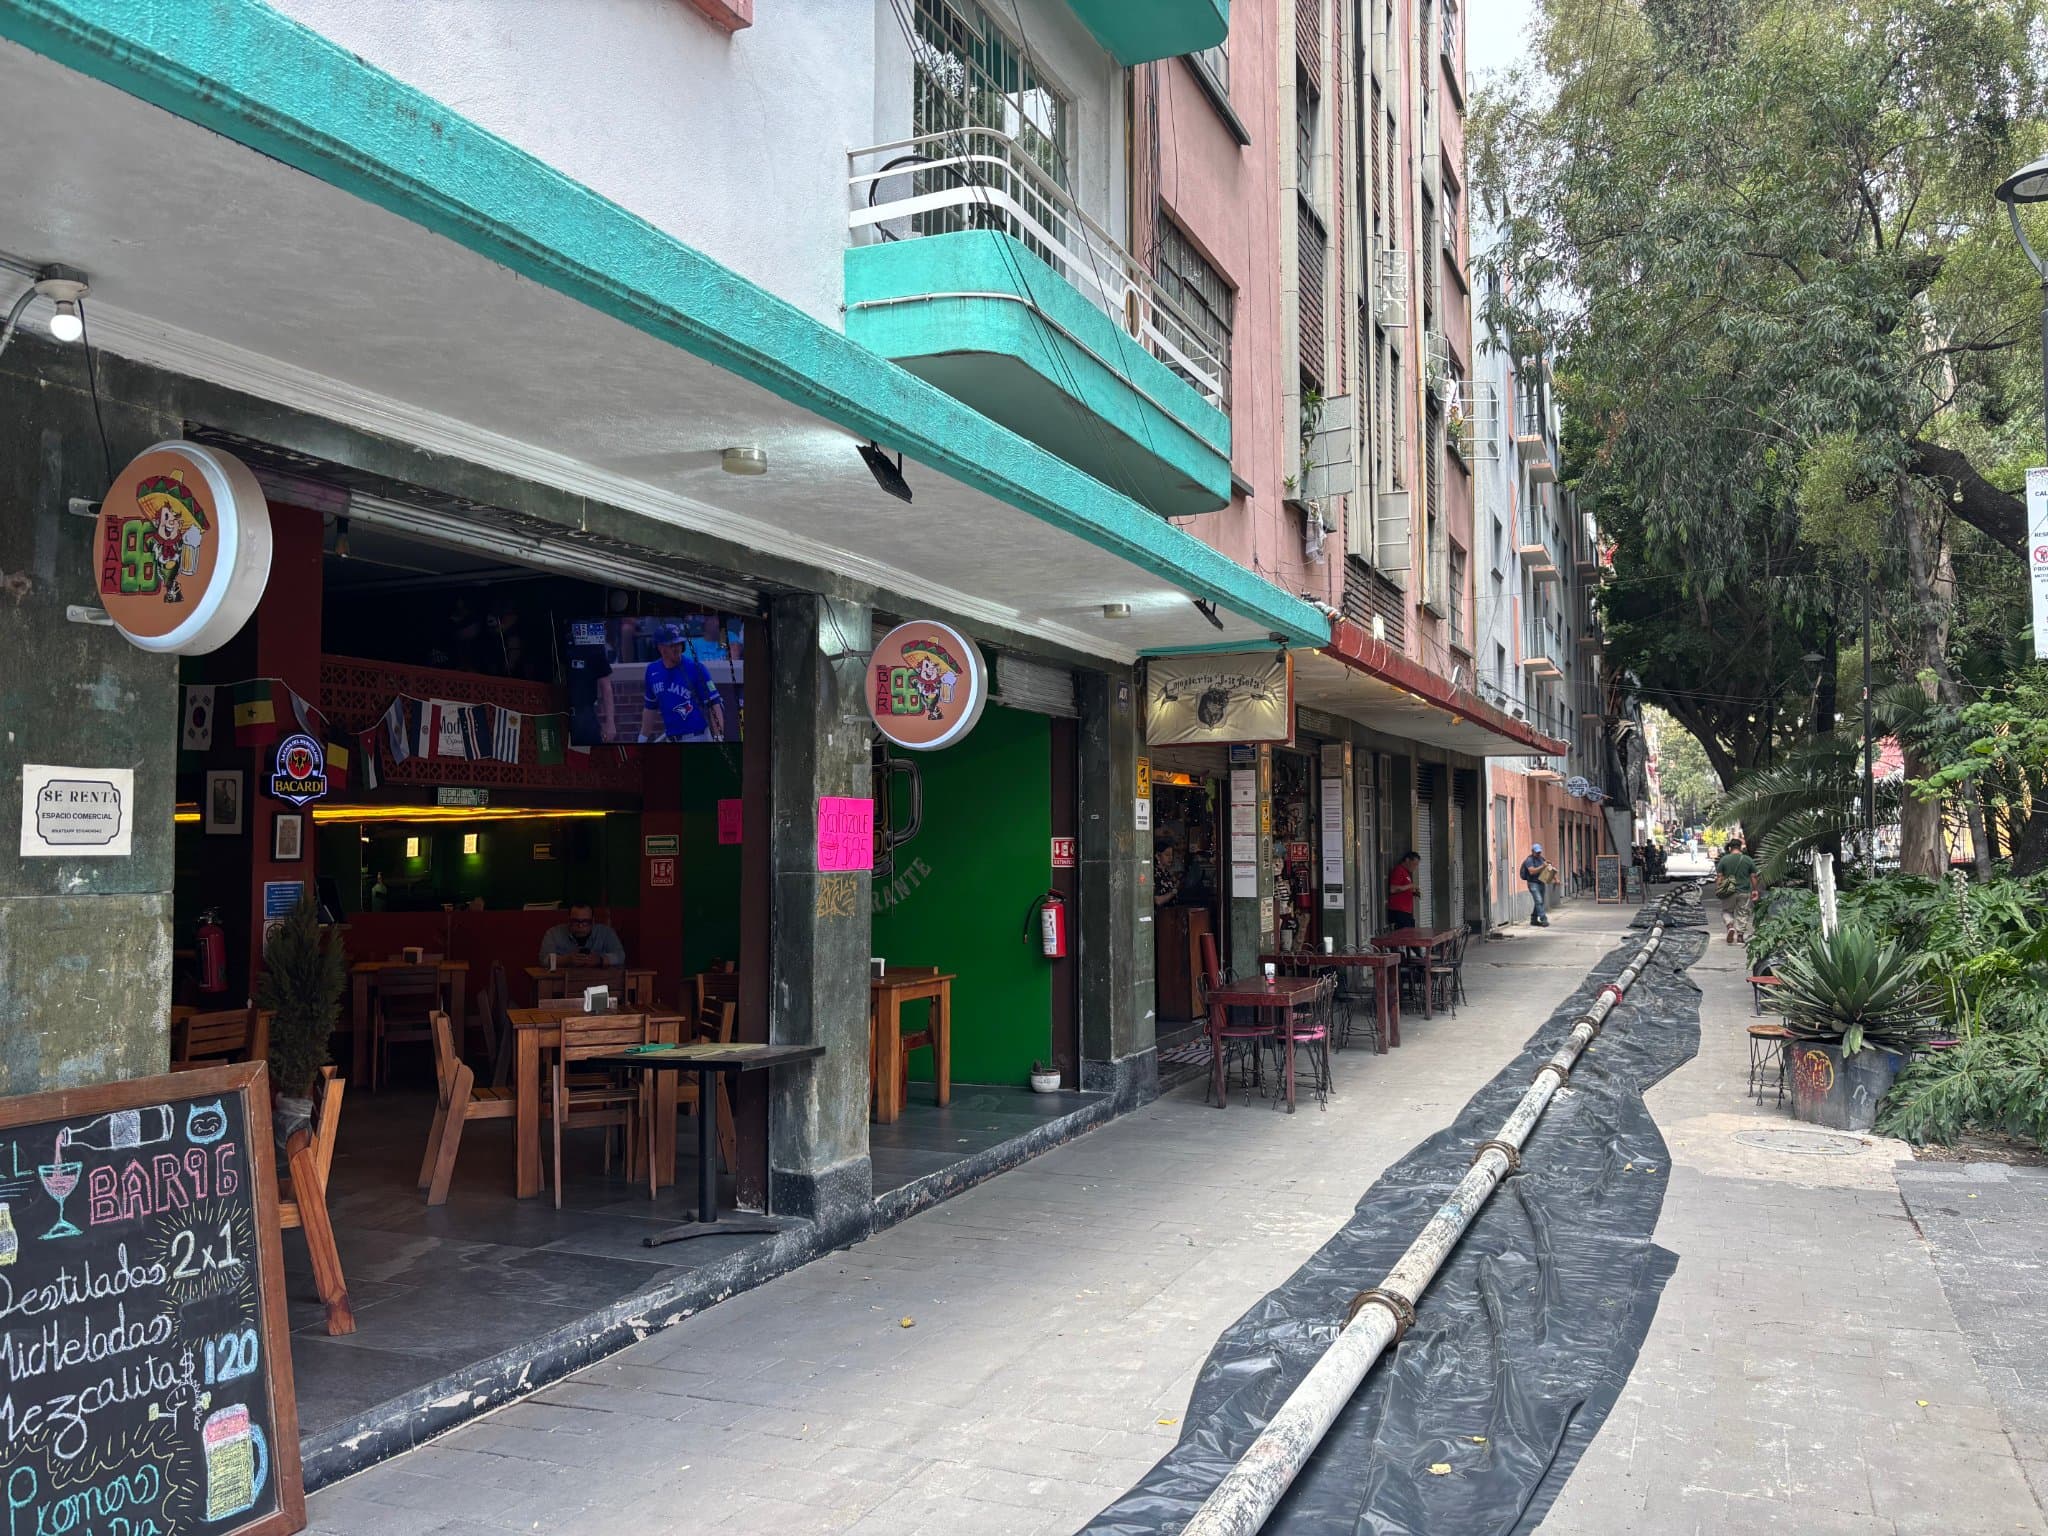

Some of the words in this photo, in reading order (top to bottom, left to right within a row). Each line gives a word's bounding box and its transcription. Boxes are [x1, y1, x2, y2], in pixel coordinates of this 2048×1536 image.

[104, 525, 119, 586] BAR
[121, 519, 158, 593] 96
[667, 682, 692, 700] JAYS
[877, 671, 889, 711] BAR
[891, 667, 923, 715] 96
[275, 779, 324, 792] BACARDÍ
[44, 790, 63, 802] SE
[70, 790, 118, 803] RENTA
[41, 812, 71, 820] ESPACIO
[72, 812, 113, 820] COMERCIAL
[171, 1219, 241, 1280] 2x1
